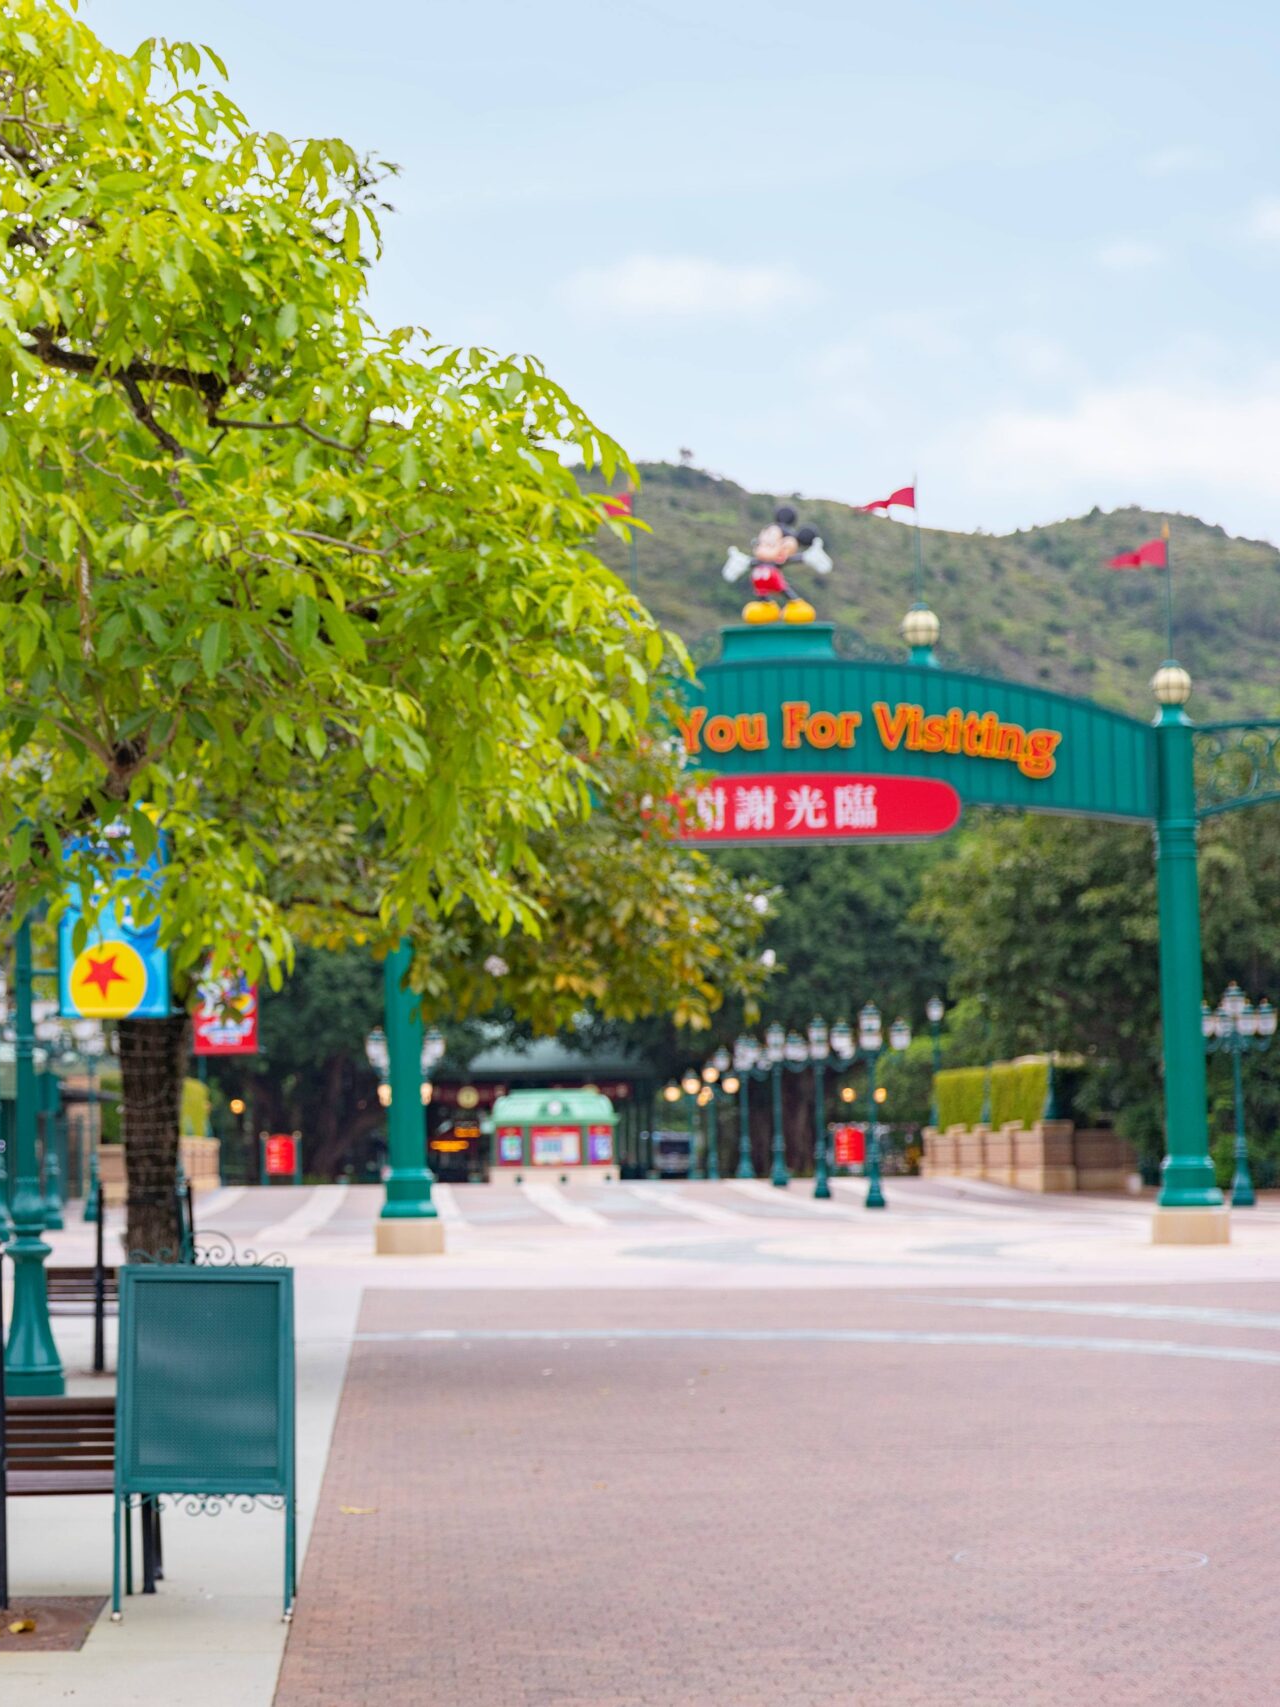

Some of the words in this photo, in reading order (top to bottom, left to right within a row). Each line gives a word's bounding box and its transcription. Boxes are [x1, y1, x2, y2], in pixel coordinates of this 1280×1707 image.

[677, 705, 769, 754] You
[782, 701, 862, 749] For
[872, 701, 1062, 779] Visiting
